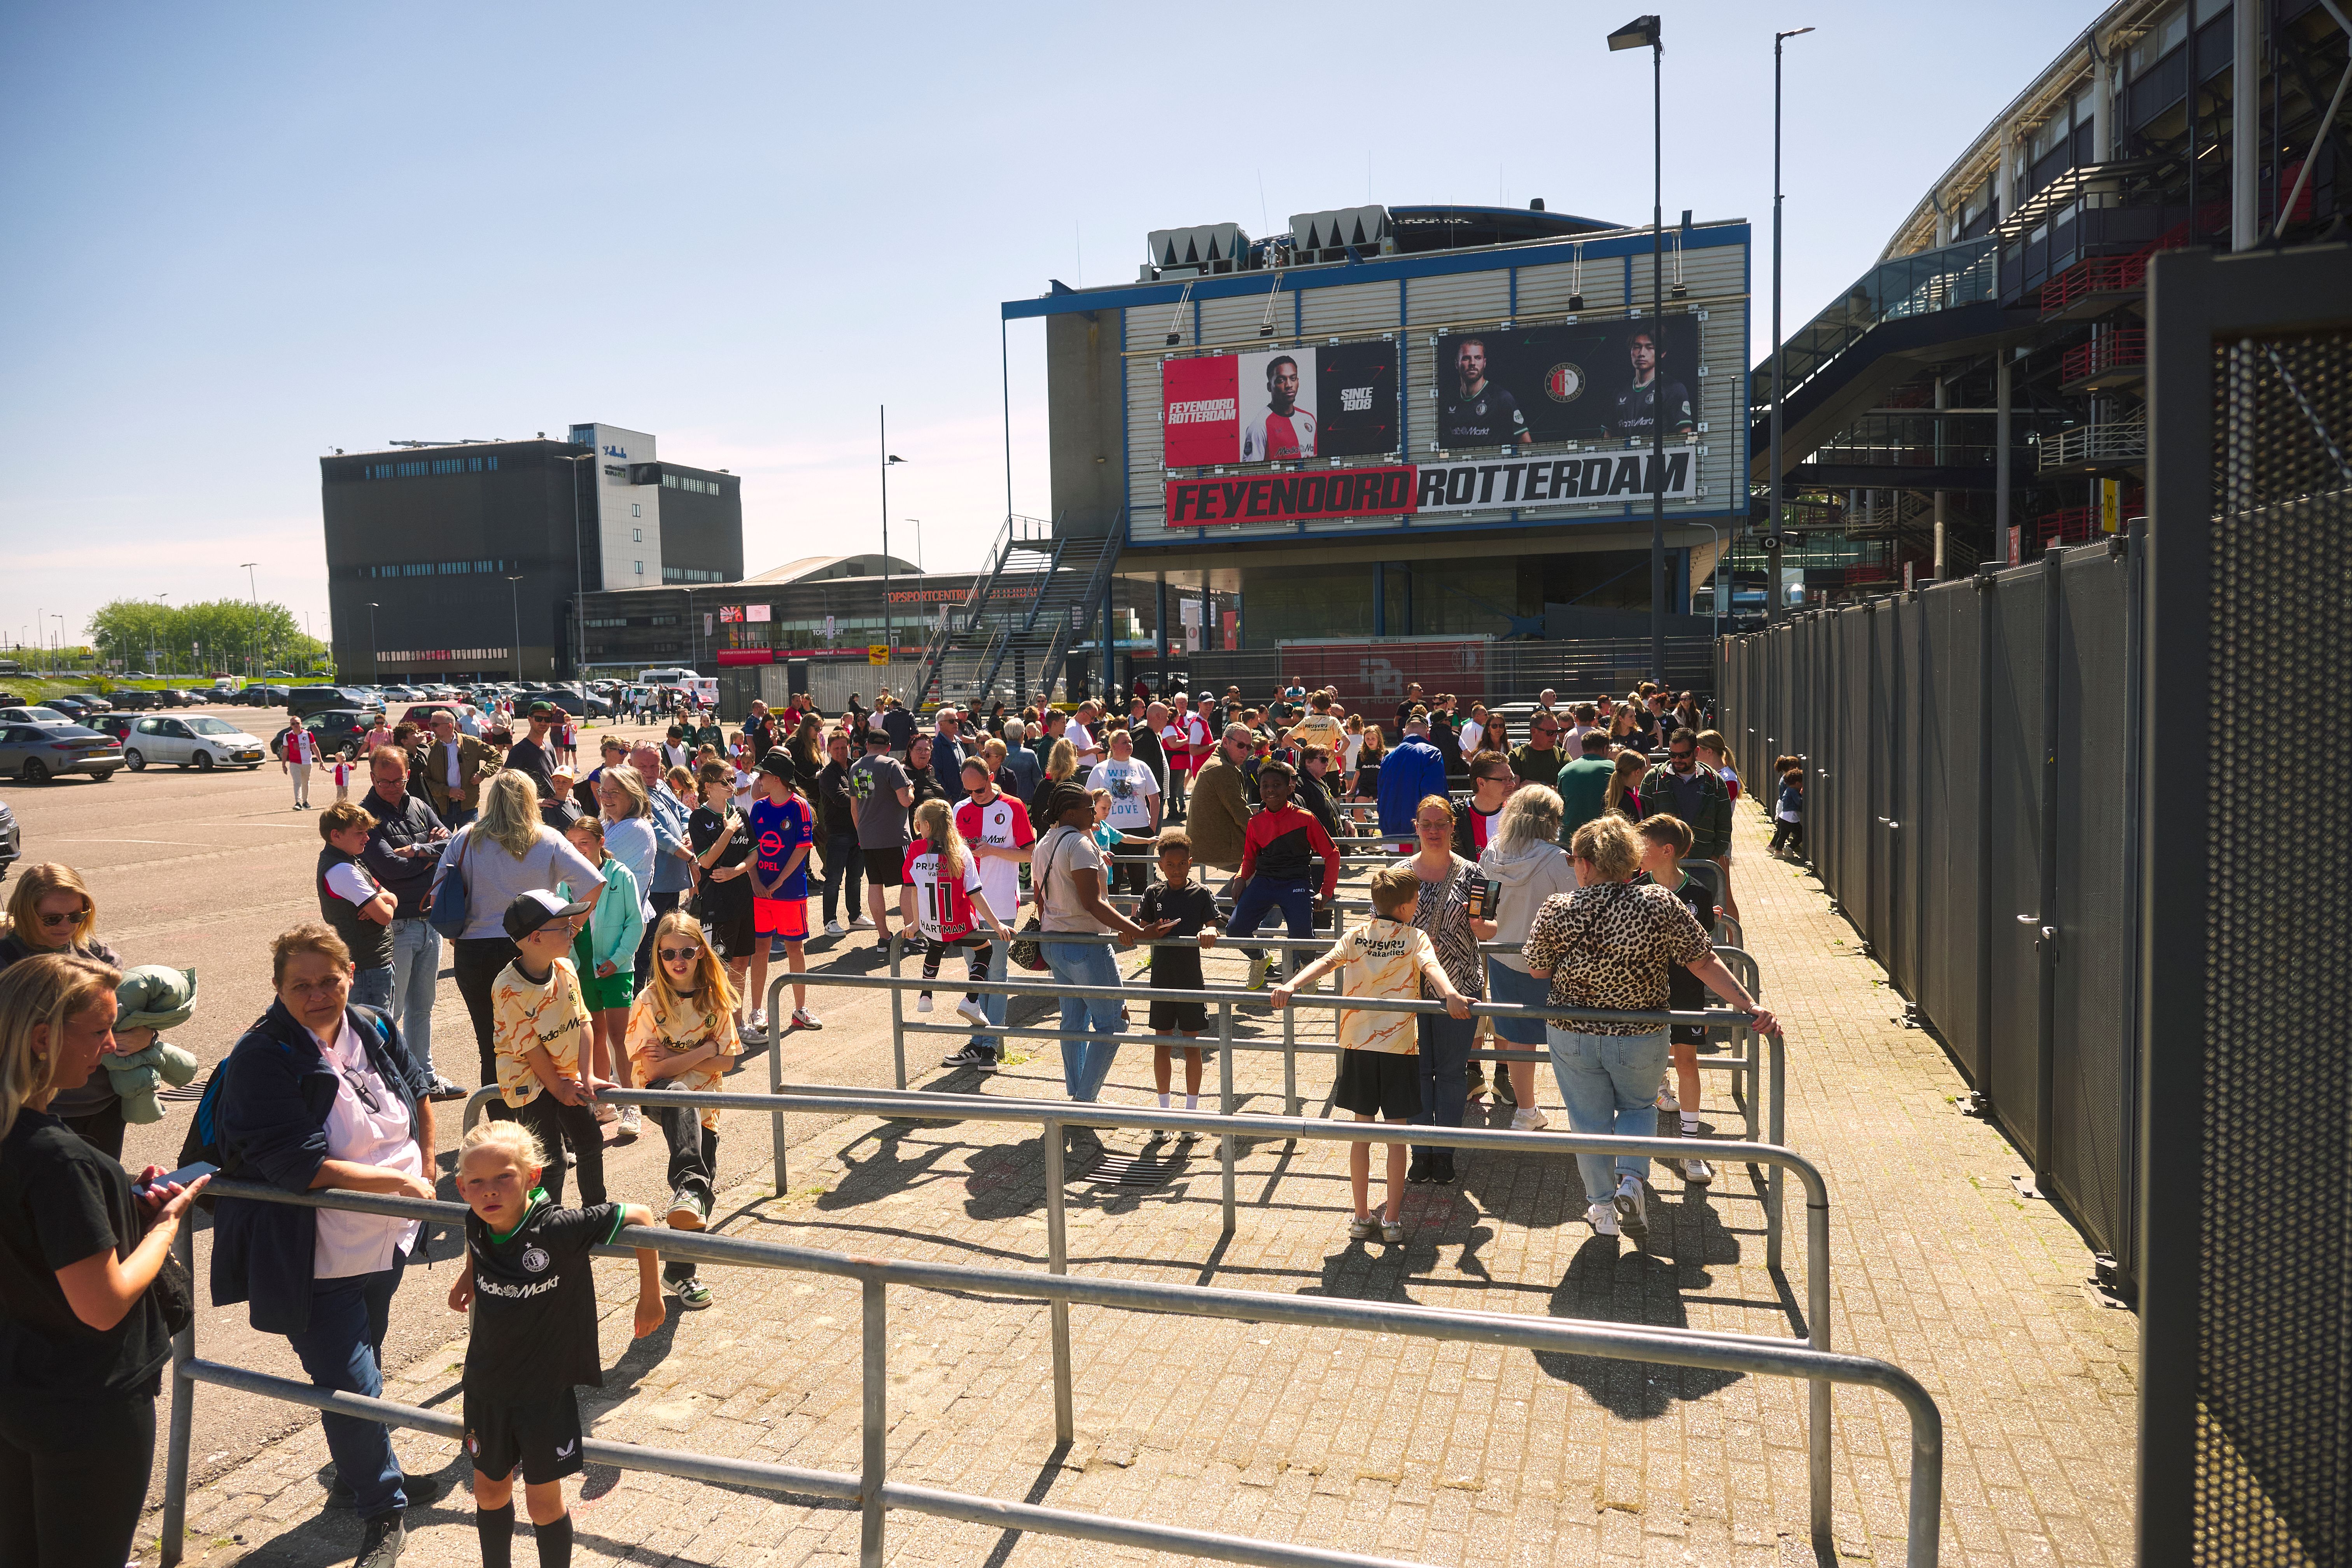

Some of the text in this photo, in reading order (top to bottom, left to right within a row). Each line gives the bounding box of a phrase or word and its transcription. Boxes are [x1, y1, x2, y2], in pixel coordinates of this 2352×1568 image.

[1549, 364, 1582, 378] FEYENOORD
[1557, 373, 1572, 392] F
[1340, 387, 1373, 401] SINCE
[1548, 387, 1582, 401] ROTTERDAM
[1169, 398, 1235, 413] FEYENOORD
[1344, 398, 1372, 411] 1908
[1168, 409, 1236, 424] ROTTERDAM
[1274, 446, 1299, 458] Media
[1172, 452, 1690, 521] FEYENOORD ROTTERDAM
[2107, 494, 2113, 519] 19
[2011, 537, 2016, 557] 18
[882, 588, 979, 603] OPSPORTCENTRUM
[1111, 805, 1139, 815] LOVE
[758, 860, 780, 871] OPEL
[925, 882, 953, 922] 11
[920, 920, 966, 934] HARTMAN
[1367, 949, 1405, 957] vakanties
[662, 1036, 685, 1048] Media
[516, 1275, 560, 1298] Markt
